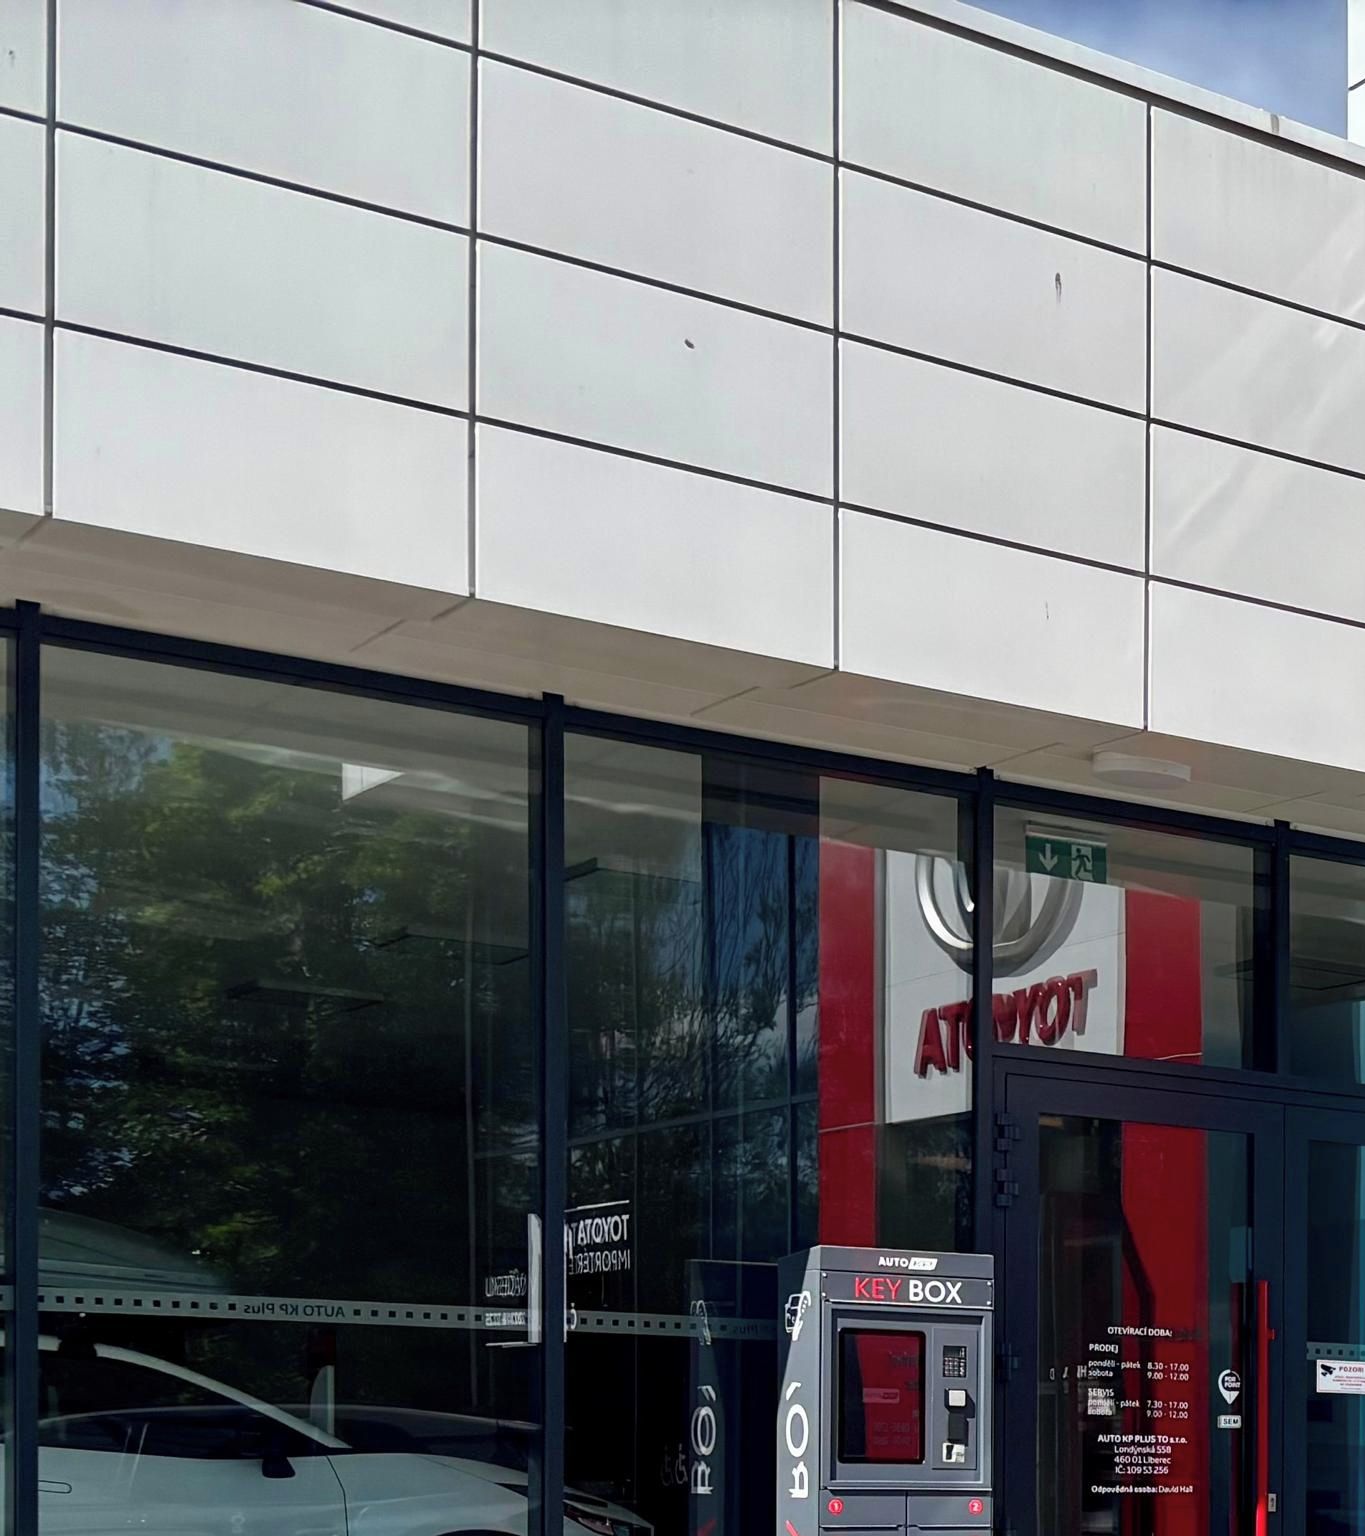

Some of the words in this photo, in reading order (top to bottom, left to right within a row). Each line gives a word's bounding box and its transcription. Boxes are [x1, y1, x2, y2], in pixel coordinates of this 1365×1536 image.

[878, 1256, 909, 1267] AUTO
[855, 1277, 902, 1299] KEY
[909, 1279, 962, 1304] BOX
[1107, 1326, 1147, 1336] OTEVÍRACÍ
[1148, 1328, 1172, 1337] DOBA:
[1089, 1343, 1119, 1354] PRODEJ
[1121, 1361, 1140, 1370] pátek
[1170, 1363, 1189, 1371] 17.00
[1170, 1373, 1189, 1381] 12.00
[1121, 1400, 1140, 1408] pátek
[1169, 1402, 1188, 1410] 17.00
[1169, 1411, 1188, 1419] 12.00
[1097, 1434, 1121, 1443] AUTO
[1122, 1435, 1134, 1443] KP
[1135, 1435, 1156, 1443] PLUS
[1158, 1435, 1168, 1443] TO
[1114, 1445, 1155, 1455] Londýnská
[1114, 1456, 1130, 1464] 460
[1132, 1456, 1142, 1464] 01
[1143, 1456, 1171, 1464] Liberec
[1127, 1466, 1141, 1474] 109
